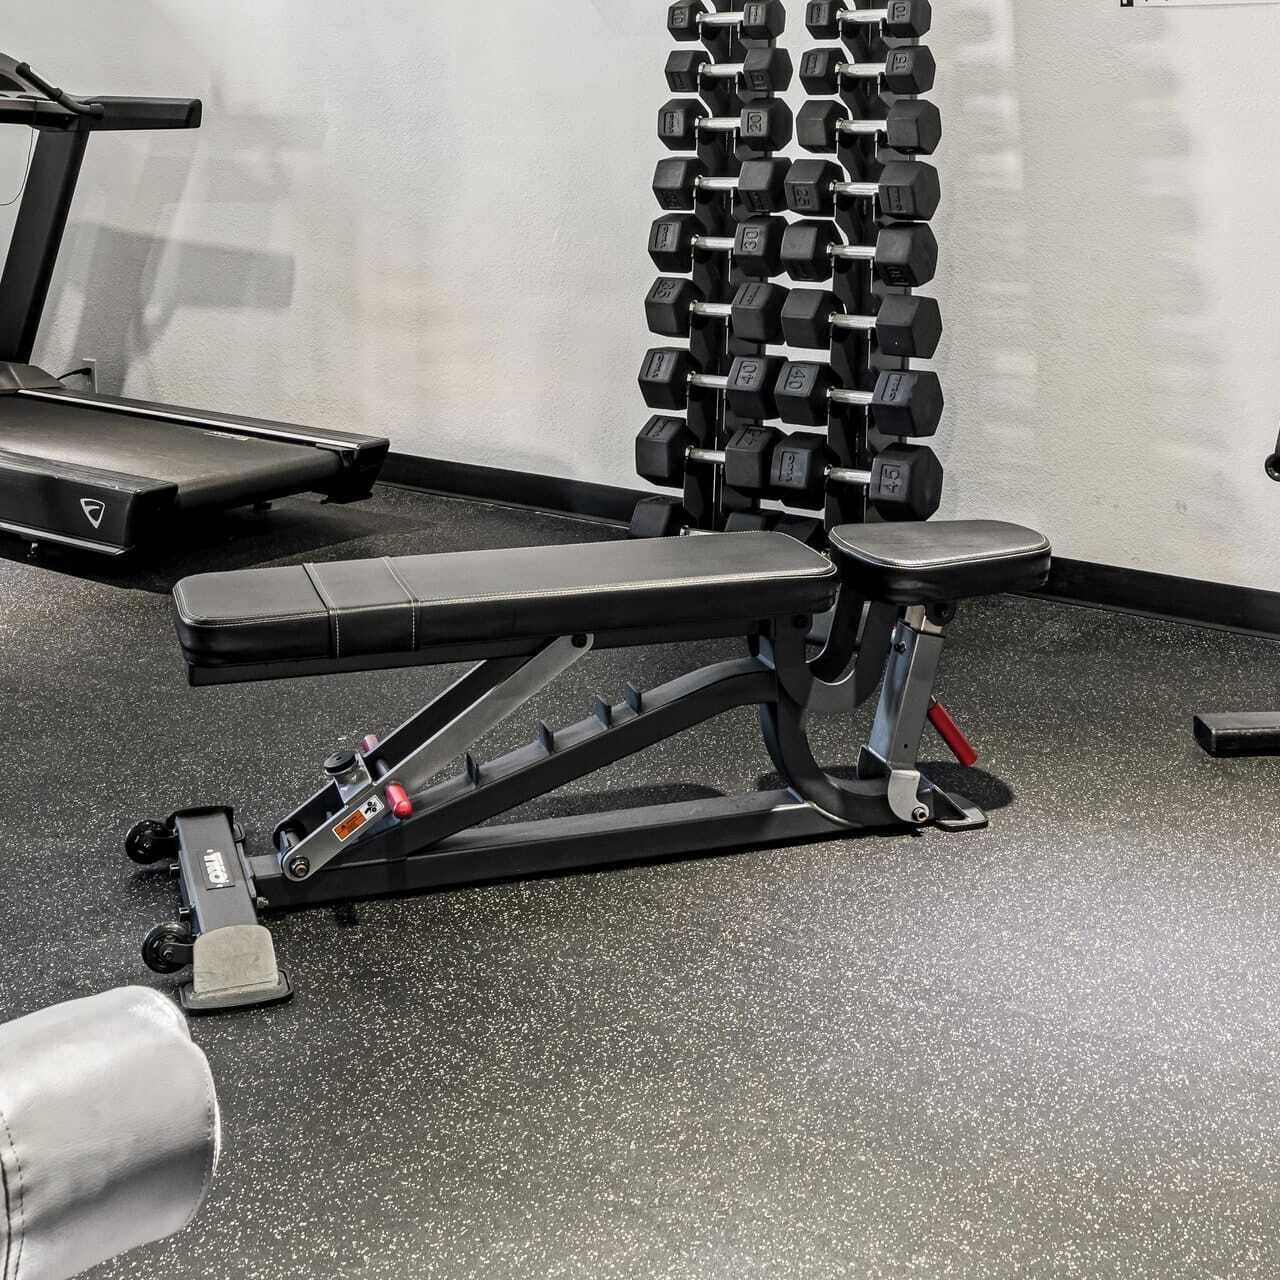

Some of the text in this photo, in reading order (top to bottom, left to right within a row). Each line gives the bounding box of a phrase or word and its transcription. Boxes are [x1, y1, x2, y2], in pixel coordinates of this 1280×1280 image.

[743, 230, 759, 250] 30
[741, 364, 758, 384] 40
[788, 370, 806, 390] 40
[885, 469, 900, 494] 45
[204, 851, 229, 883] TKO
